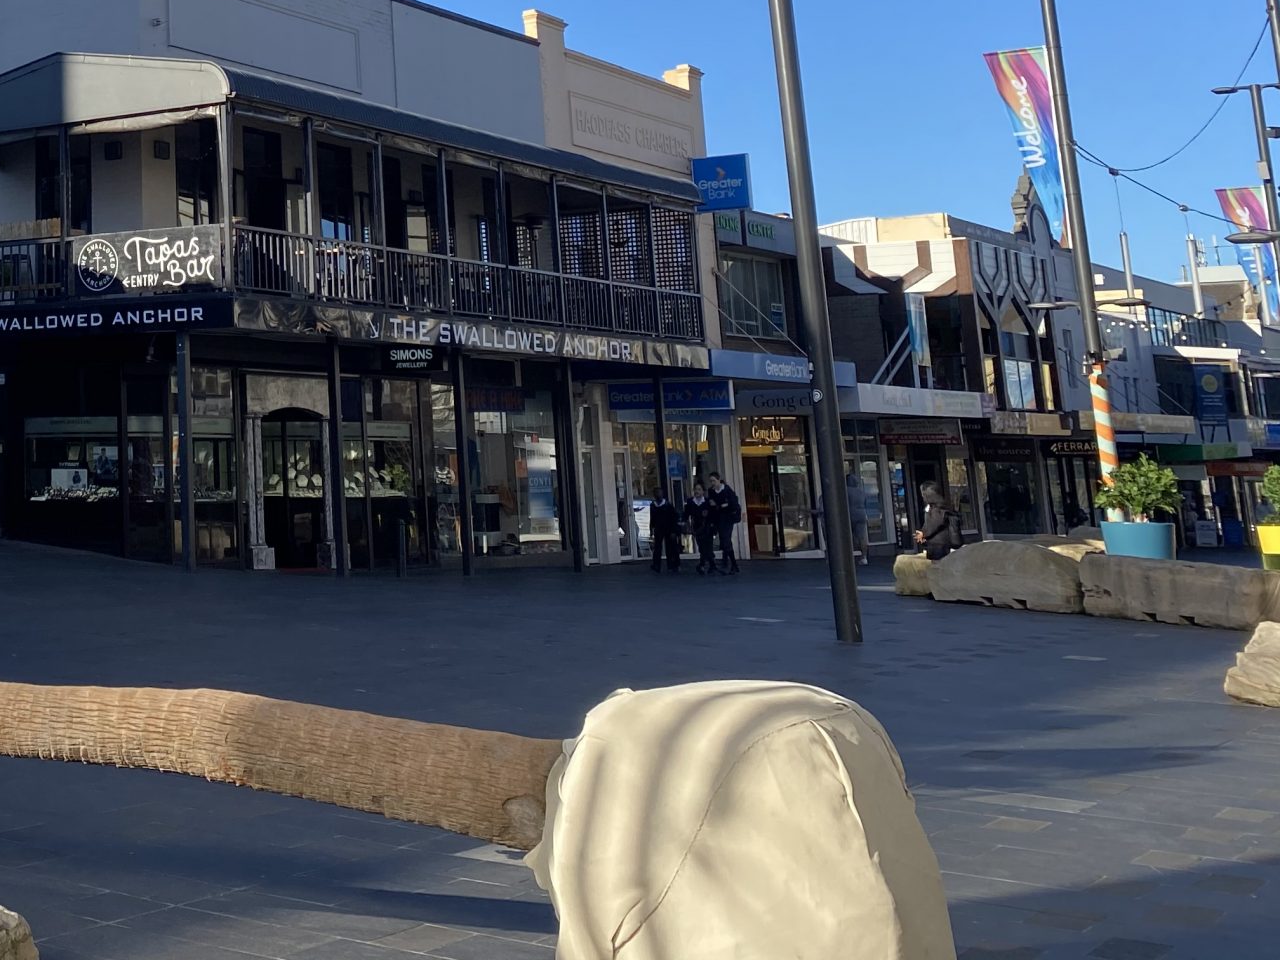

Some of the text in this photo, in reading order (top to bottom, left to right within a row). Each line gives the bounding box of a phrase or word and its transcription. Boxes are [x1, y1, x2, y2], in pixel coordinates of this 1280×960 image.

[1011, 75, 1046, 168] Welcome
[698, 178, 743, 190] Greater
[708, 188, 736, 200] Bank
[124, 236, 199, 272] Tapas
[163, 255, 215, 286] Bar
[86, 275, 111, 288] ANCHOR
[131, 273, 159, 287] ENTRY
[112, 307, 204, 325] ANCHOR
[389, 317, 632, 360] THE SWALLOWED ANCHOR
[390, 349, 433, 360] SIMONS
[610, 390, 684, 403] Greater ank
[700, 388, 728, 400] ATM
[752, 394, 797, 412] Gong
[752, 425, 769, 443] Gong
[769, 425, 781, 440] cha
[1057, 441, 1097, 451] FERRAR
